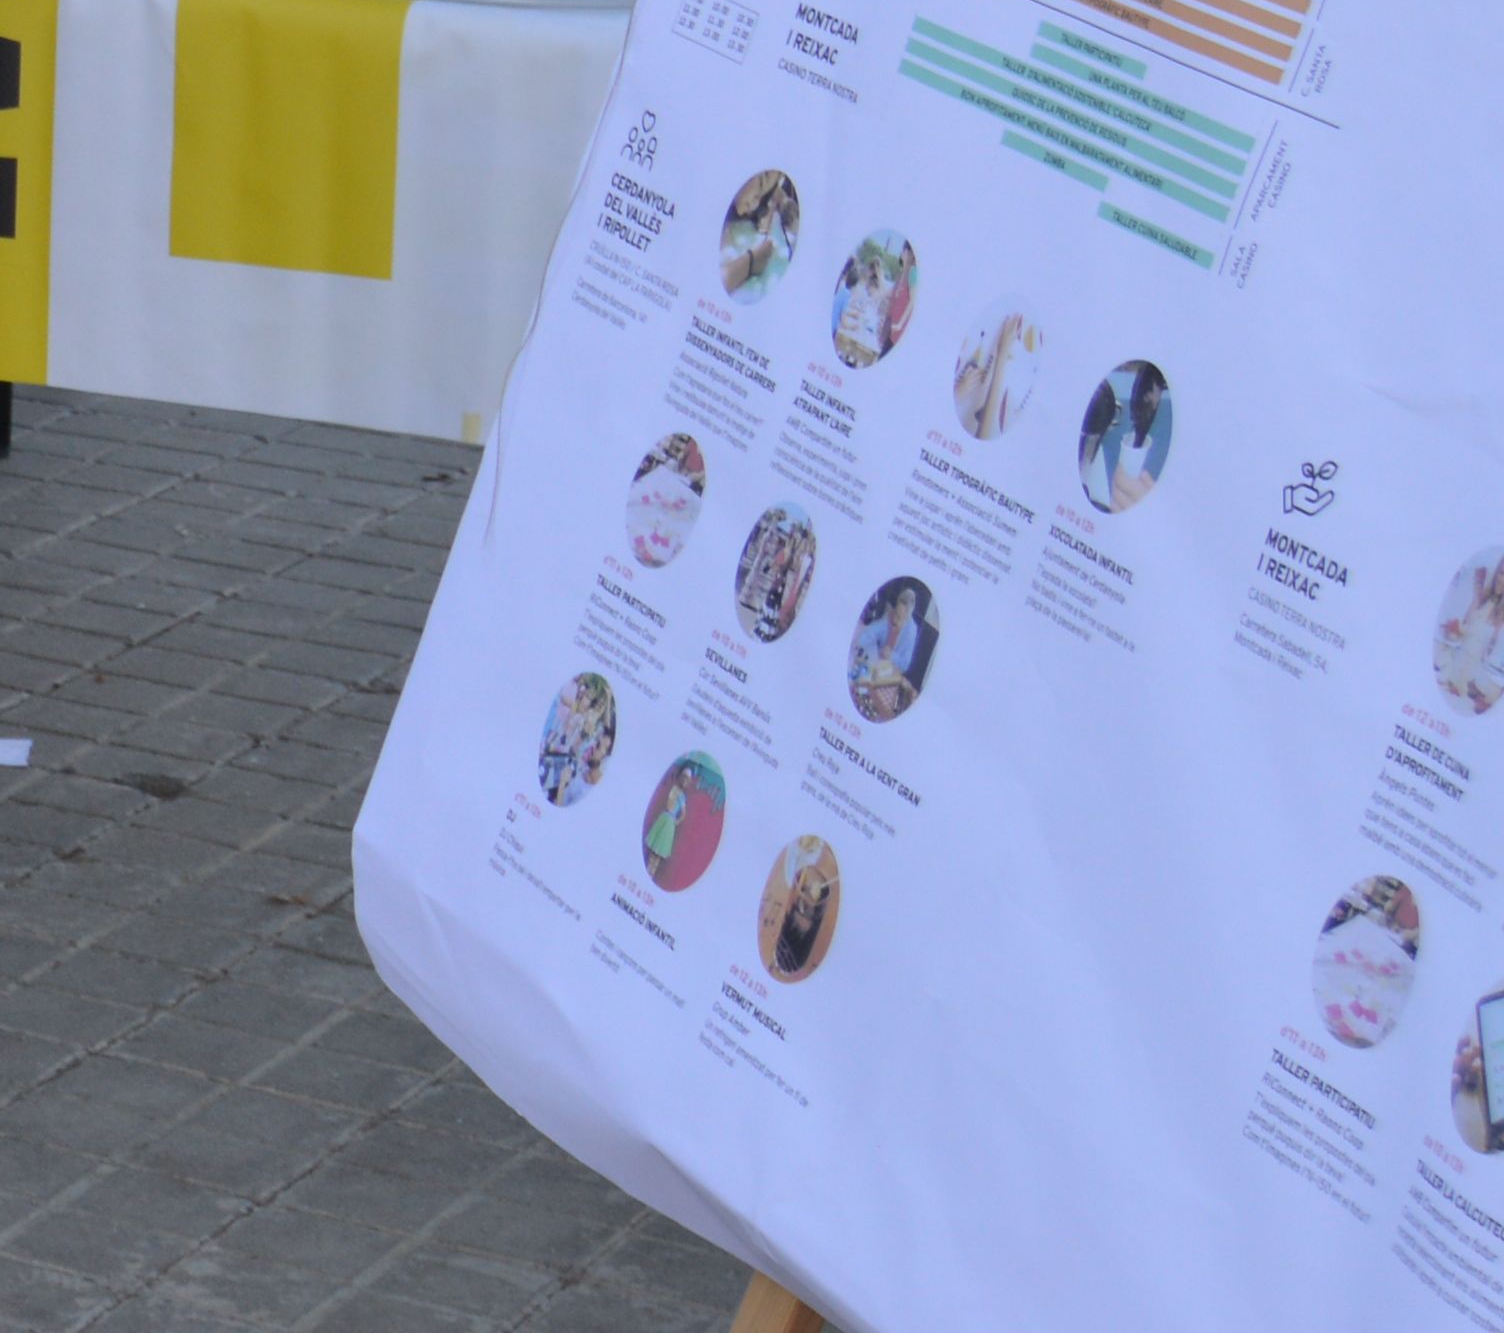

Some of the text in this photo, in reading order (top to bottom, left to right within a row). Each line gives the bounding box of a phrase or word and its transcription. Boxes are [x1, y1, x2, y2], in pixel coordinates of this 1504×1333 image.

[795, 3, 860, 46] MONTCADA
[777, 57, 807, 82] CASINO
[792, 32, 839, 66] REIXAC
[603, 192, 623, 216] DEL
[611, 172, 676, 219] CERDANYOLA
[1250, 139, 1288, 222] APARCAMENT
[1267, 162, 1292, 210] CASINO
[603, 215, 652, 253] RIPOLLET
[1229, 245, 1246, 277] SALA
[1236, 242, 1259, 290] CASINO
[919, 447, 950, 473] TALLER
[998, 493, 1036, 524] BAUTYPE
[1098, 551, 1134, 585] INFANTIL
[1265, 527, 1350, 587] MONTCADA
[1265, 557, 1321, 601] REIXAC
[1247, 586, 1280, 614] CASINO
[1308, 618, 1347, 651] NOSTRA
[819, 726, 845, 753] TALLER
[844, 744, 860, 764] PER
[876, 769, 898, 791] GENT
[897, 783, 921, 807] GRAN
[1394, 723, 1431, 754] TALLER
[1431, 746, 1444, 765] DE
[721, 981, 786, 1040] VERMUT MUSICAL
[1271, 1047, 1376, 1130] TALLER PARTICIPATIU
